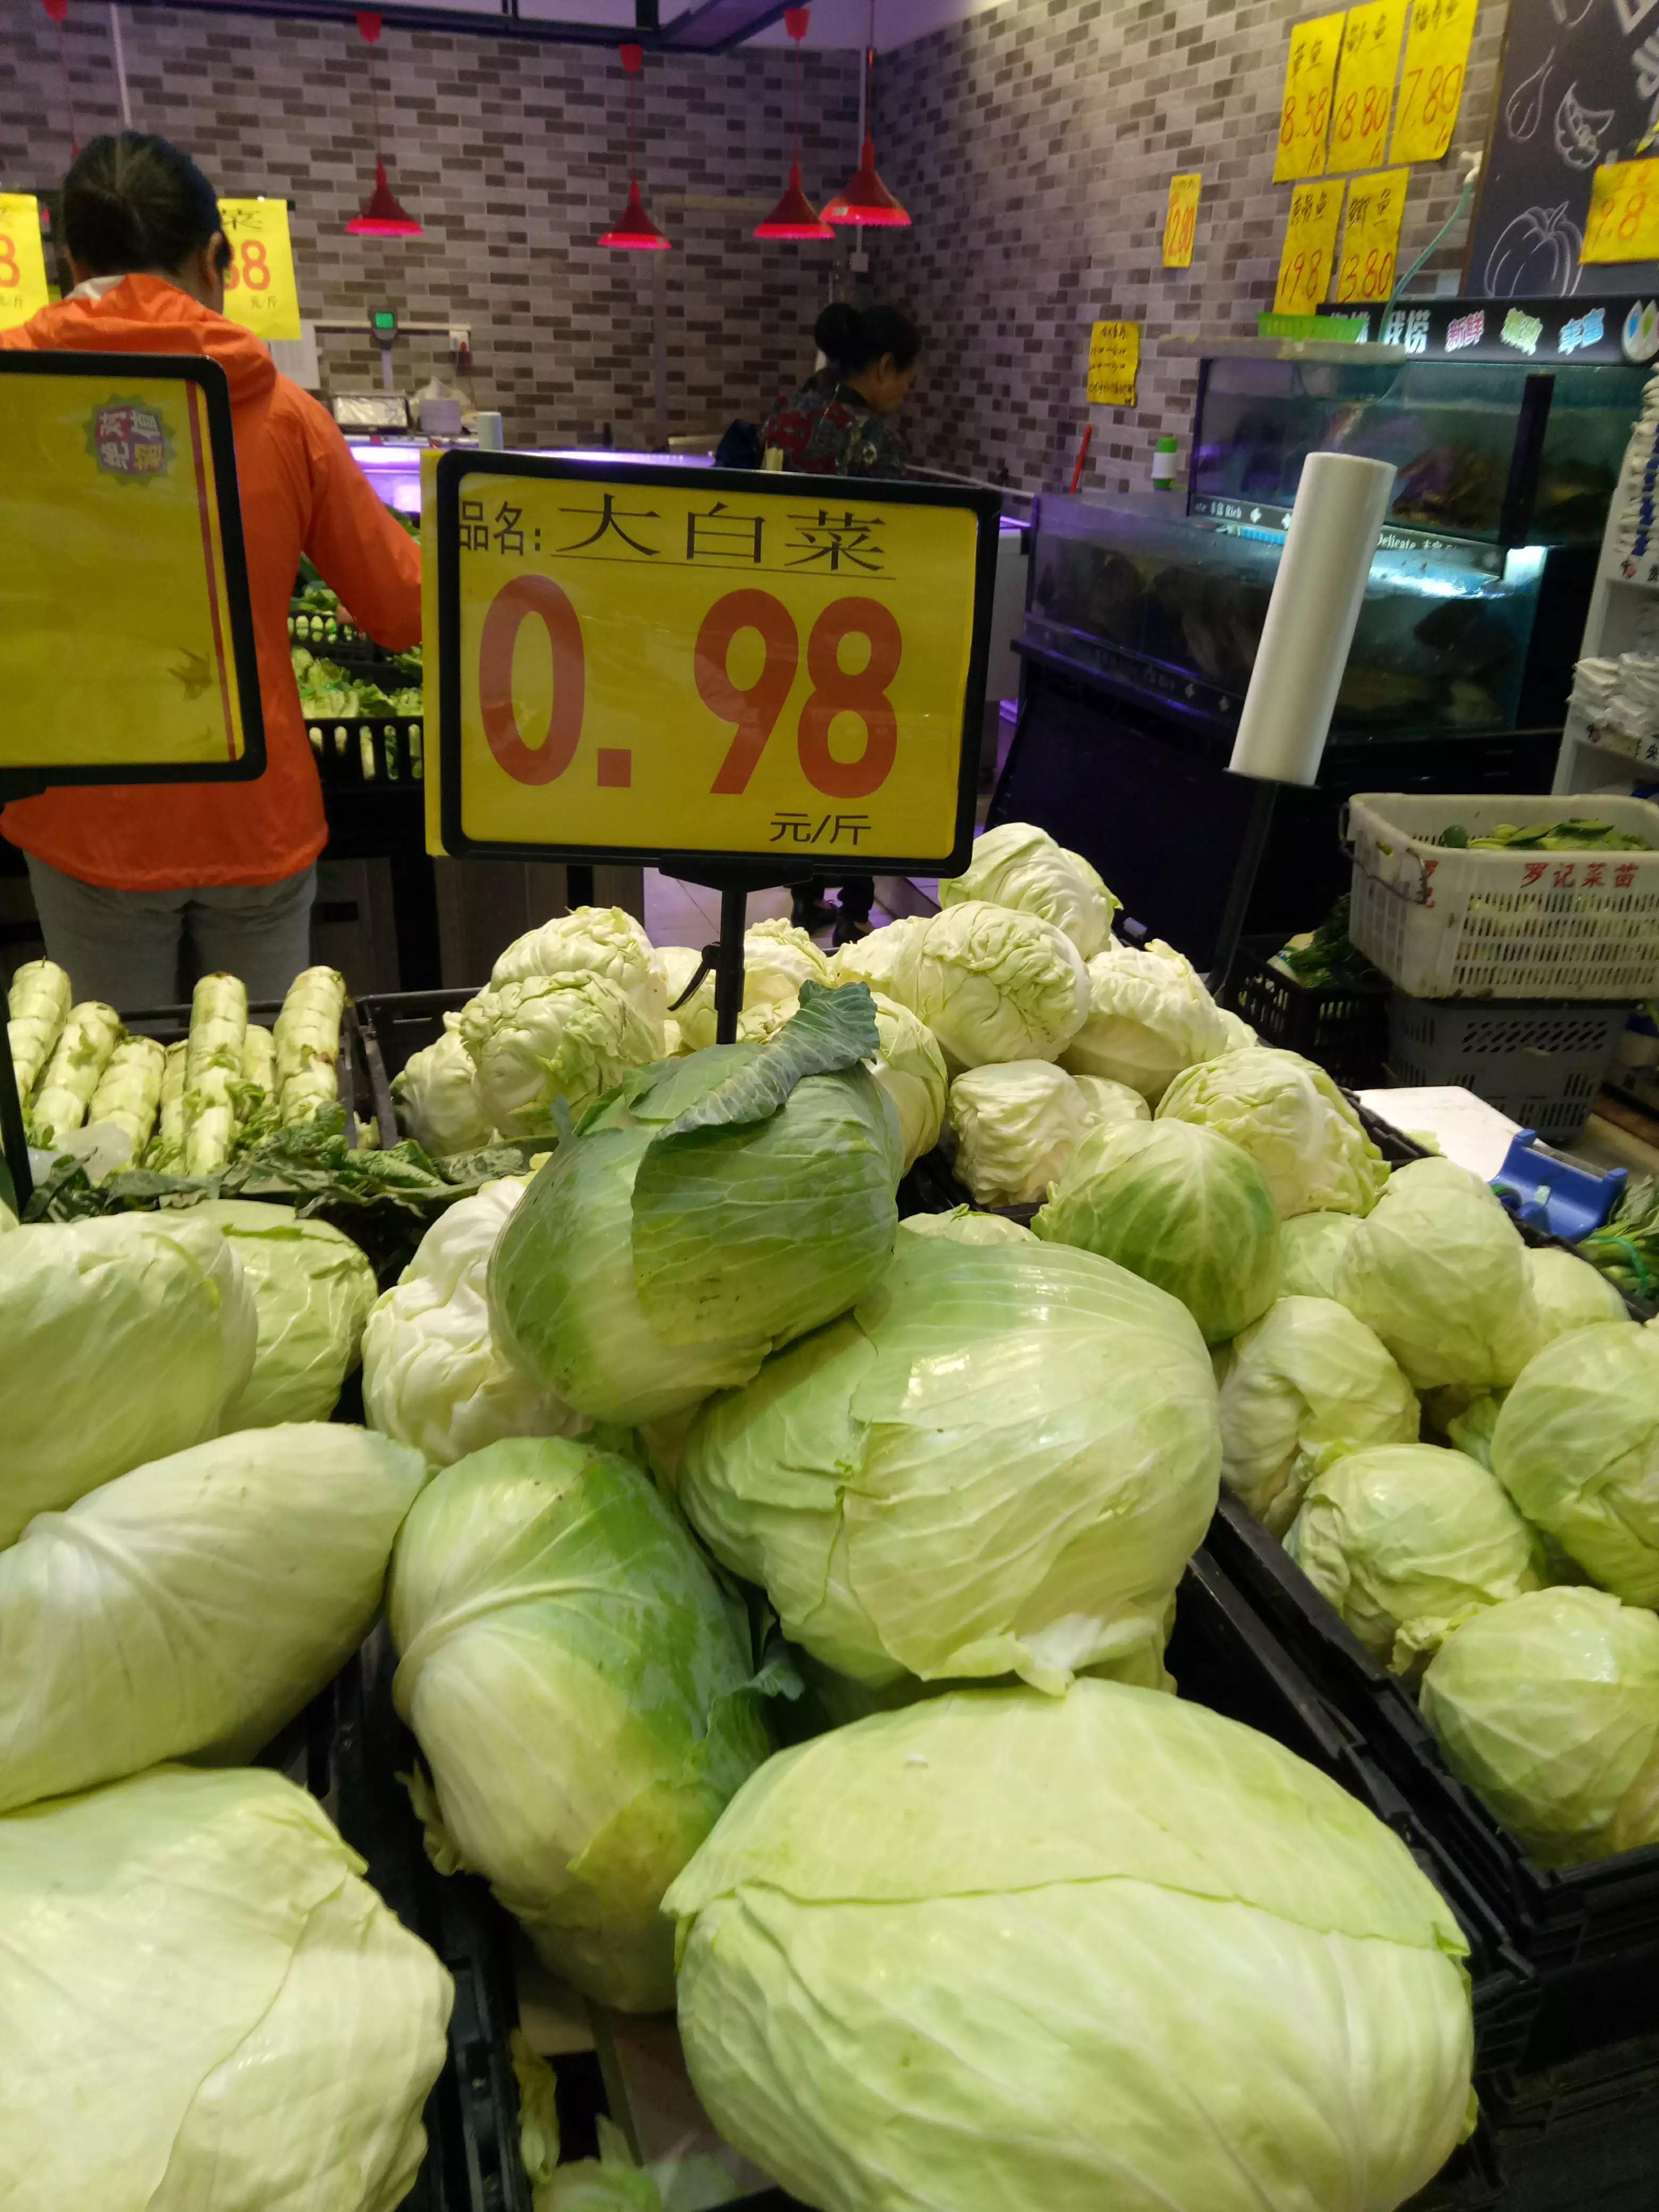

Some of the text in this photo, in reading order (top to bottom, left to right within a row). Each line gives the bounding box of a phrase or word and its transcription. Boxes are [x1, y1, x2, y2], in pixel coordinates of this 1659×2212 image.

[557, 493, 886, 572] 大白菜
[479, 574, 902, 799] 0.98
[769, 812, 872, 845] 元/斤
[1520, 861, 1639, 890] 罗记菜苗
